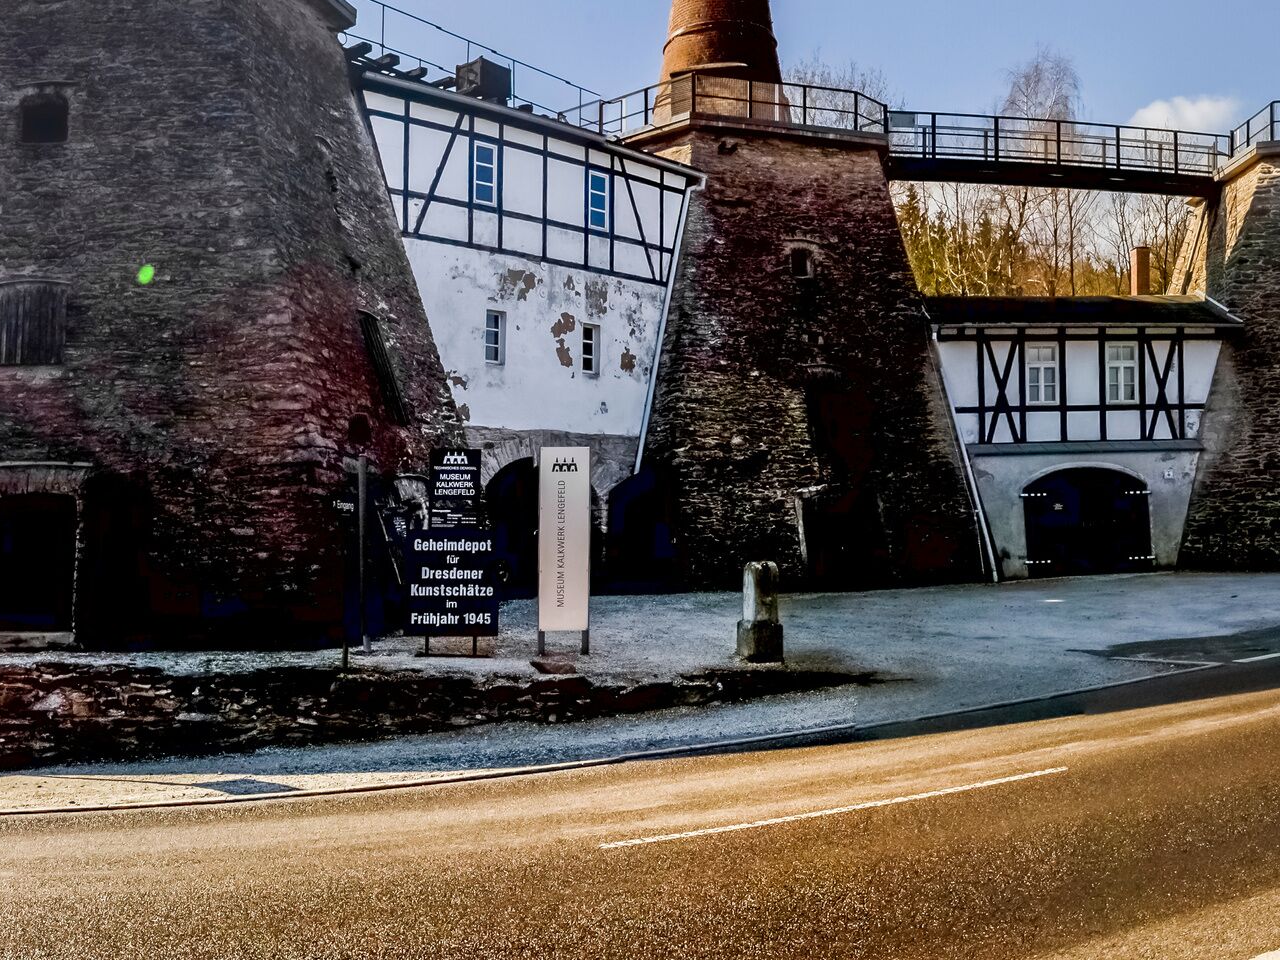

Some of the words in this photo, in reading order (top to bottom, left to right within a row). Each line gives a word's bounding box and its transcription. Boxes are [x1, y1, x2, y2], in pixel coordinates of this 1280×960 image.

[337, 500, 354, 512] Eingang
[557, 480, 566, 524] LENGEFELD
[414, 539, 492, 553] Geheimdepot
[557, 526, 565, 569] KALKWERK
[446, 555, 459, 564] für
[421, 567, 483, 579] Dresdener
[410, 584, 493, 596] Kunstschätze
[557, 571, 565, 607] MUSEUM
[446, 600, 457, 608] im
[411, 613, 459, 626] Frühjahr
[463, 613, 491, 624] 1945
